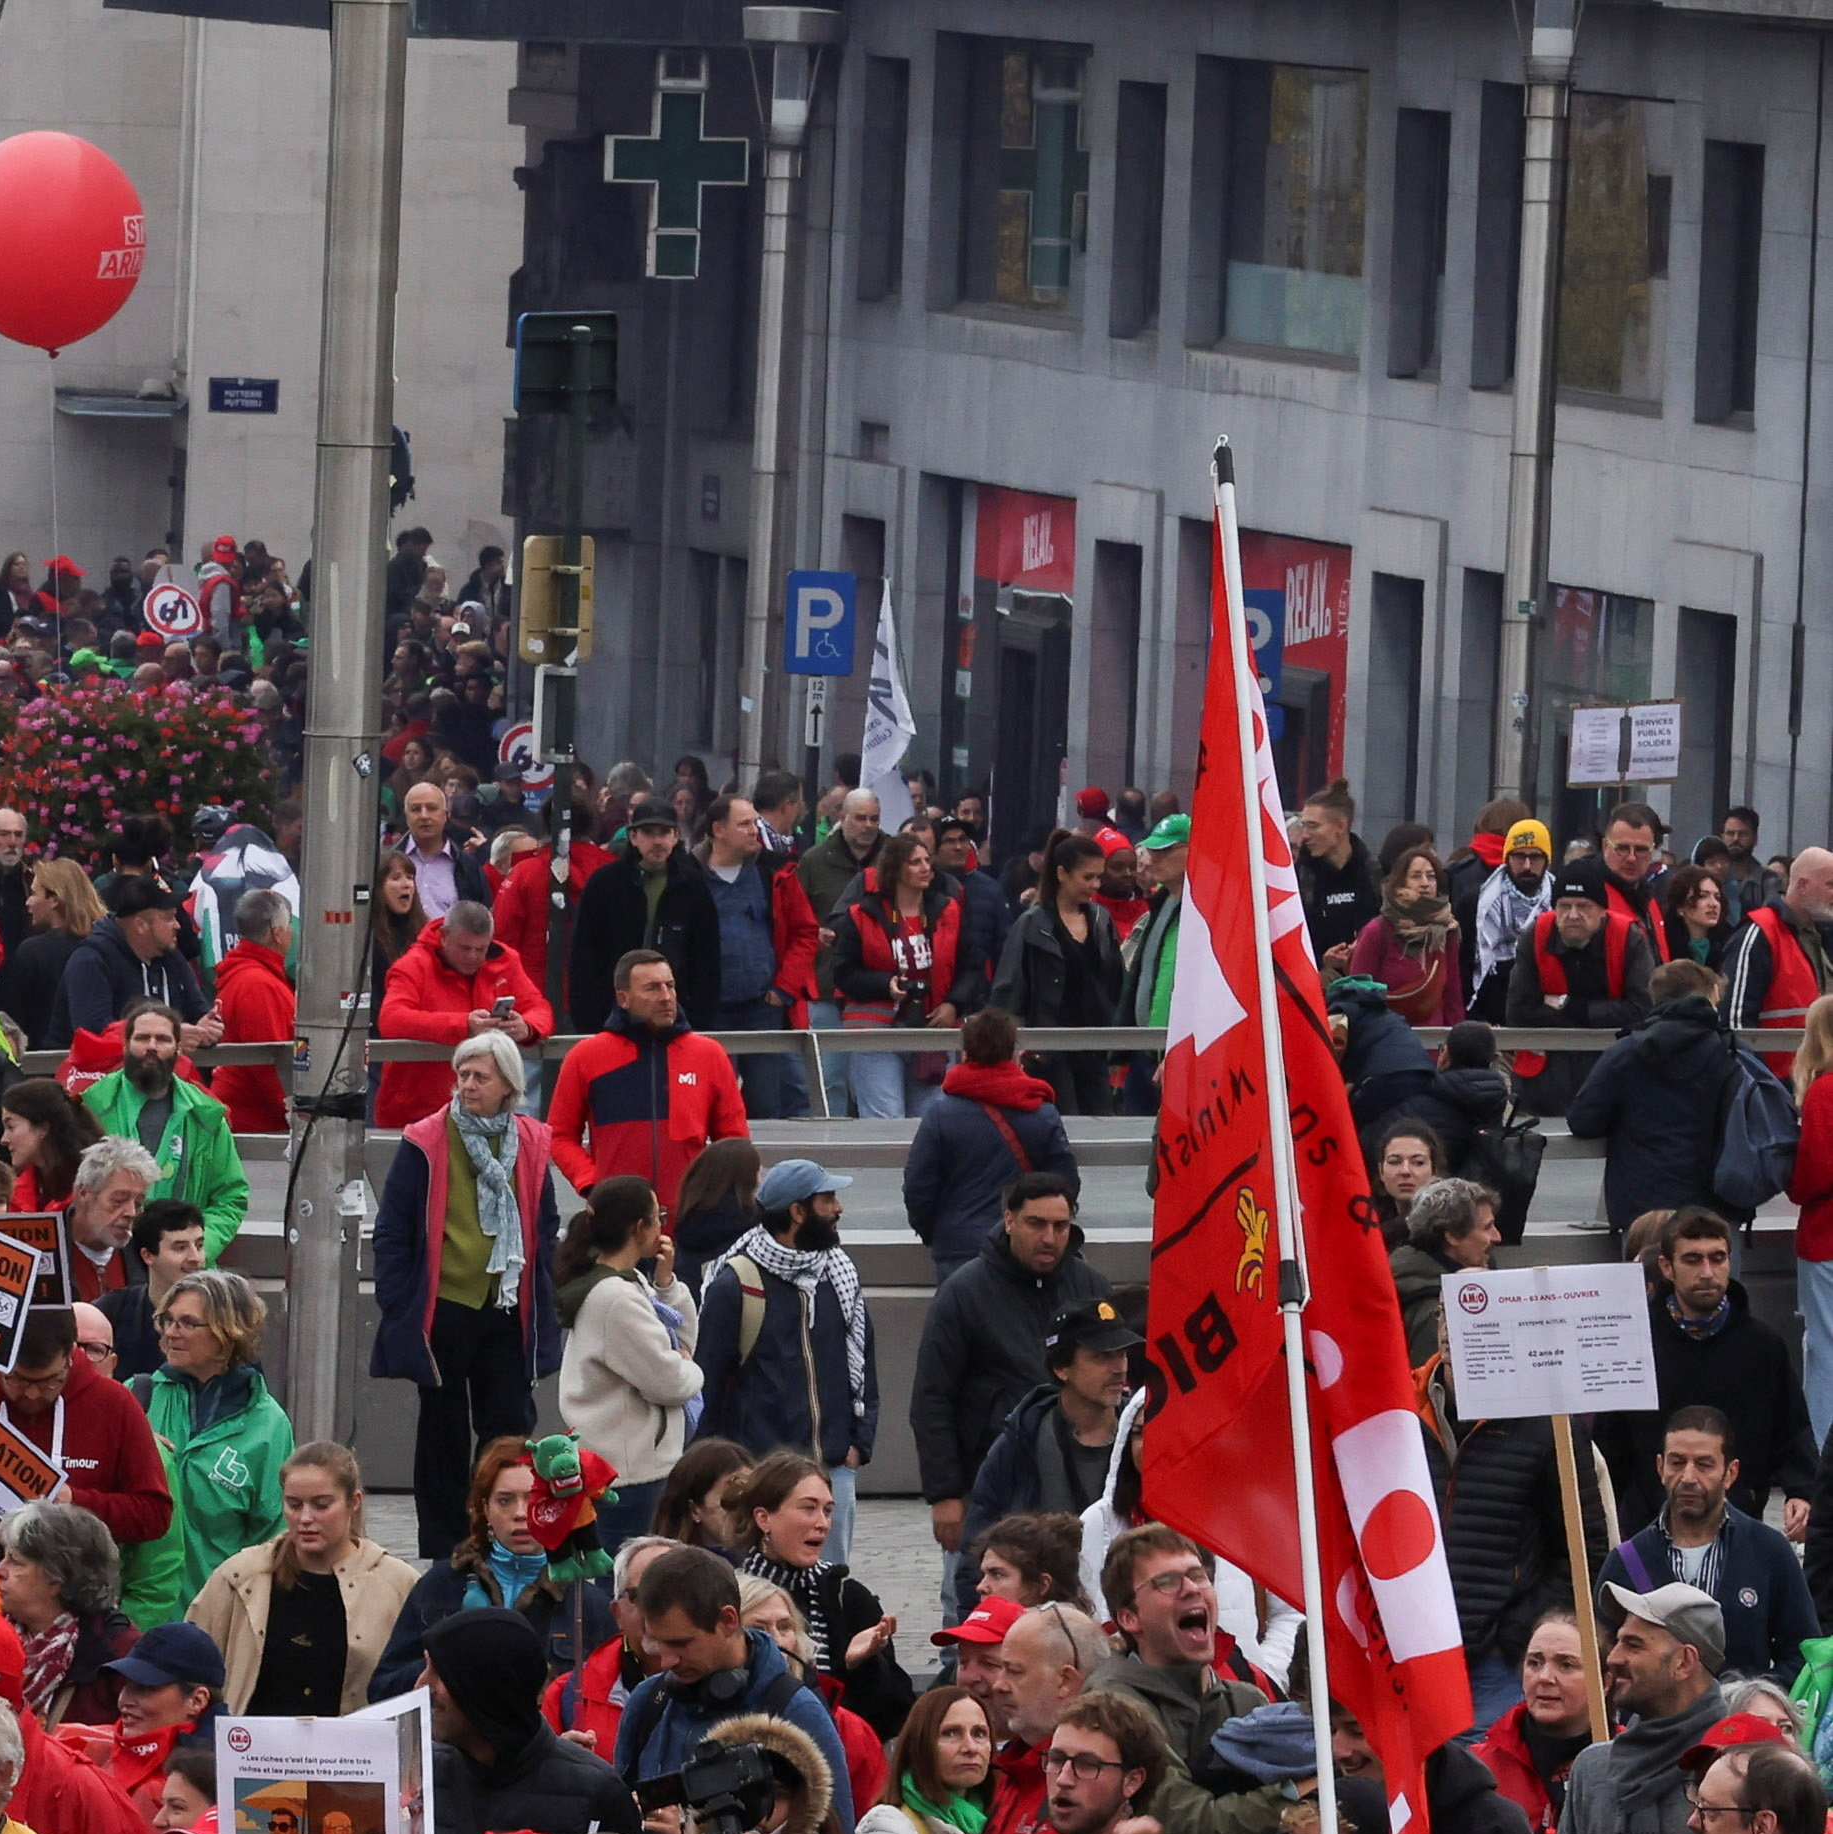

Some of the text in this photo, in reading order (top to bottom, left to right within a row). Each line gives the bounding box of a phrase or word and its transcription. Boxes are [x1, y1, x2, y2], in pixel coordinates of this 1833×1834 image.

[1284, 557, 1326, 645] RELAY
[795, 586, 842, 655] P
[1498, 1295, 1522, 1304] OMAR
[1563, 1290, 1600, 1300] OUVRIER
[1554, 1348, 1565, 1356] de
[1532, 1360, 1563, 1369] carrière
[261, 1755, 284, 1764] riches
[284, 1756, 303, 1765] c'est
[304, 1757, 318, 1765] fait
[319, 1758, 337, 1767] pour
[339, 1757, 355, 1765] être
[356, 1757, 372, 1765] très
[263, 1766, 271, 1774] et
[272, 1767, 283, 1775] les
[284, 1769, 315, 1777] pauvres
[316, 1768, 332, 1776] très
[333, 1769, 364, 1778] pauvres
